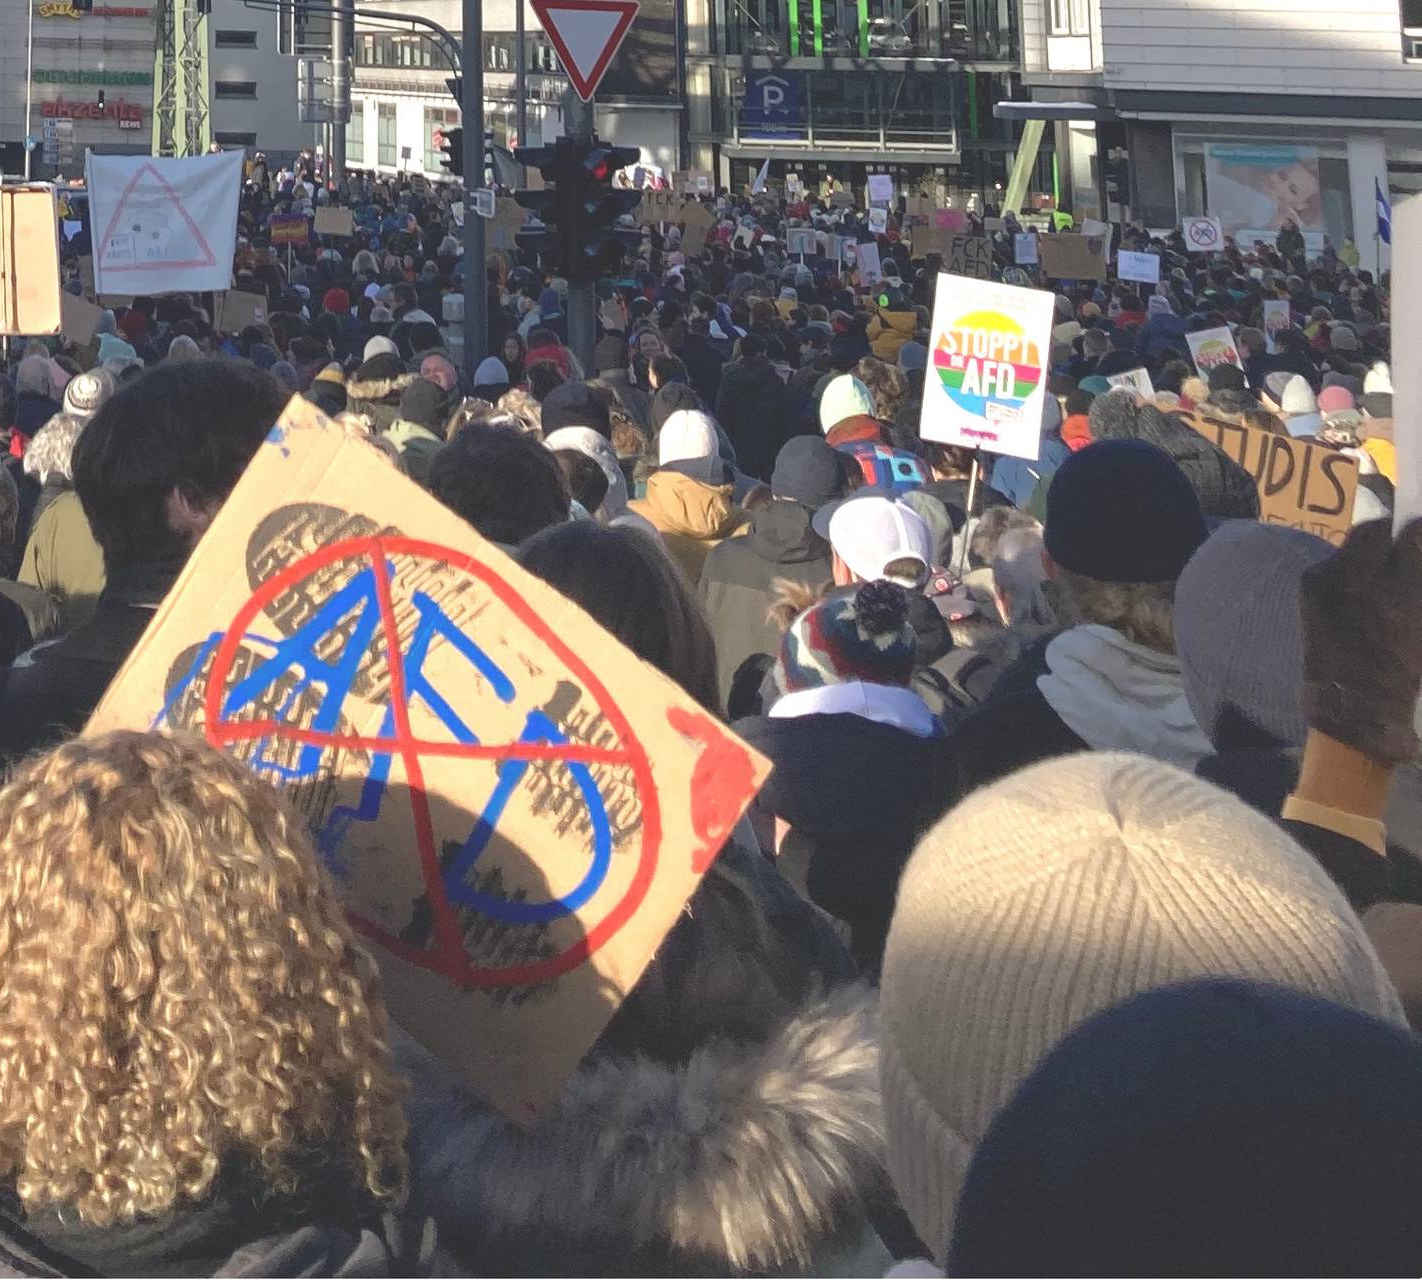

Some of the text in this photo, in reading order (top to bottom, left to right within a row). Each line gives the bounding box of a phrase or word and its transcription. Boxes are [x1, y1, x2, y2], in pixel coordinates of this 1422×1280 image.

[951, 236, 989, 258] FCK
[940, 328, 1035, 365] STOPPT
[960, 357, 1016, 400] AFD
